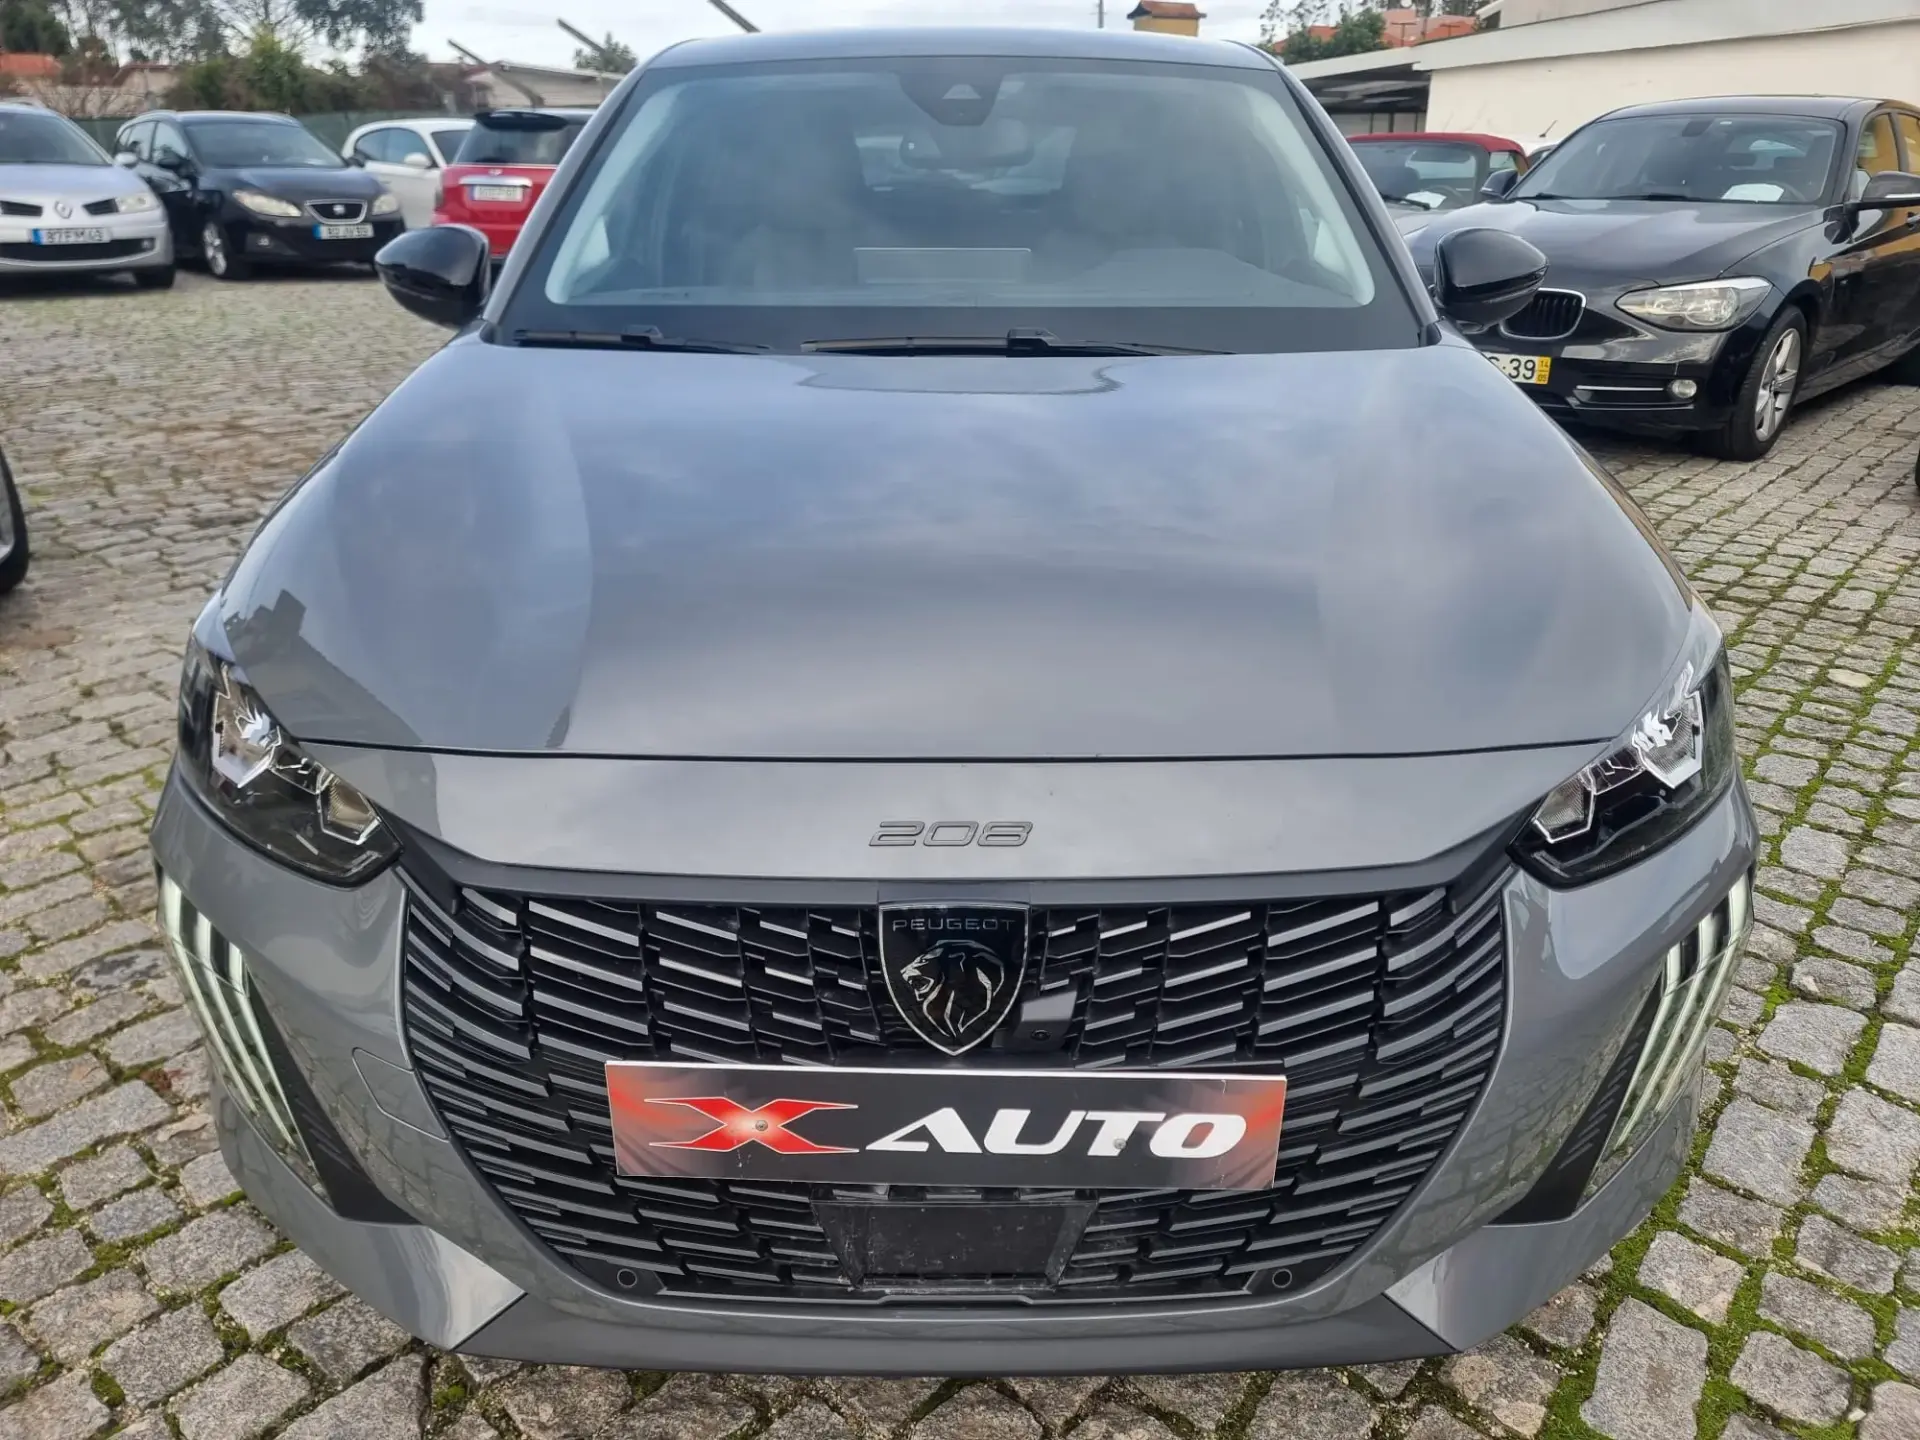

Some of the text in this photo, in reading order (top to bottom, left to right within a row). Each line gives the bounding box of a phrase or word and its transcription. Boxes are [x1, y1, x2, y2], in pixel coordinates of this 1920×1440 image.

[868, 820, 1034, 847] 208
[892, 917, 1016, 932] PEUGEOT
[644, 1097, 1247, 1159] X AUTO
